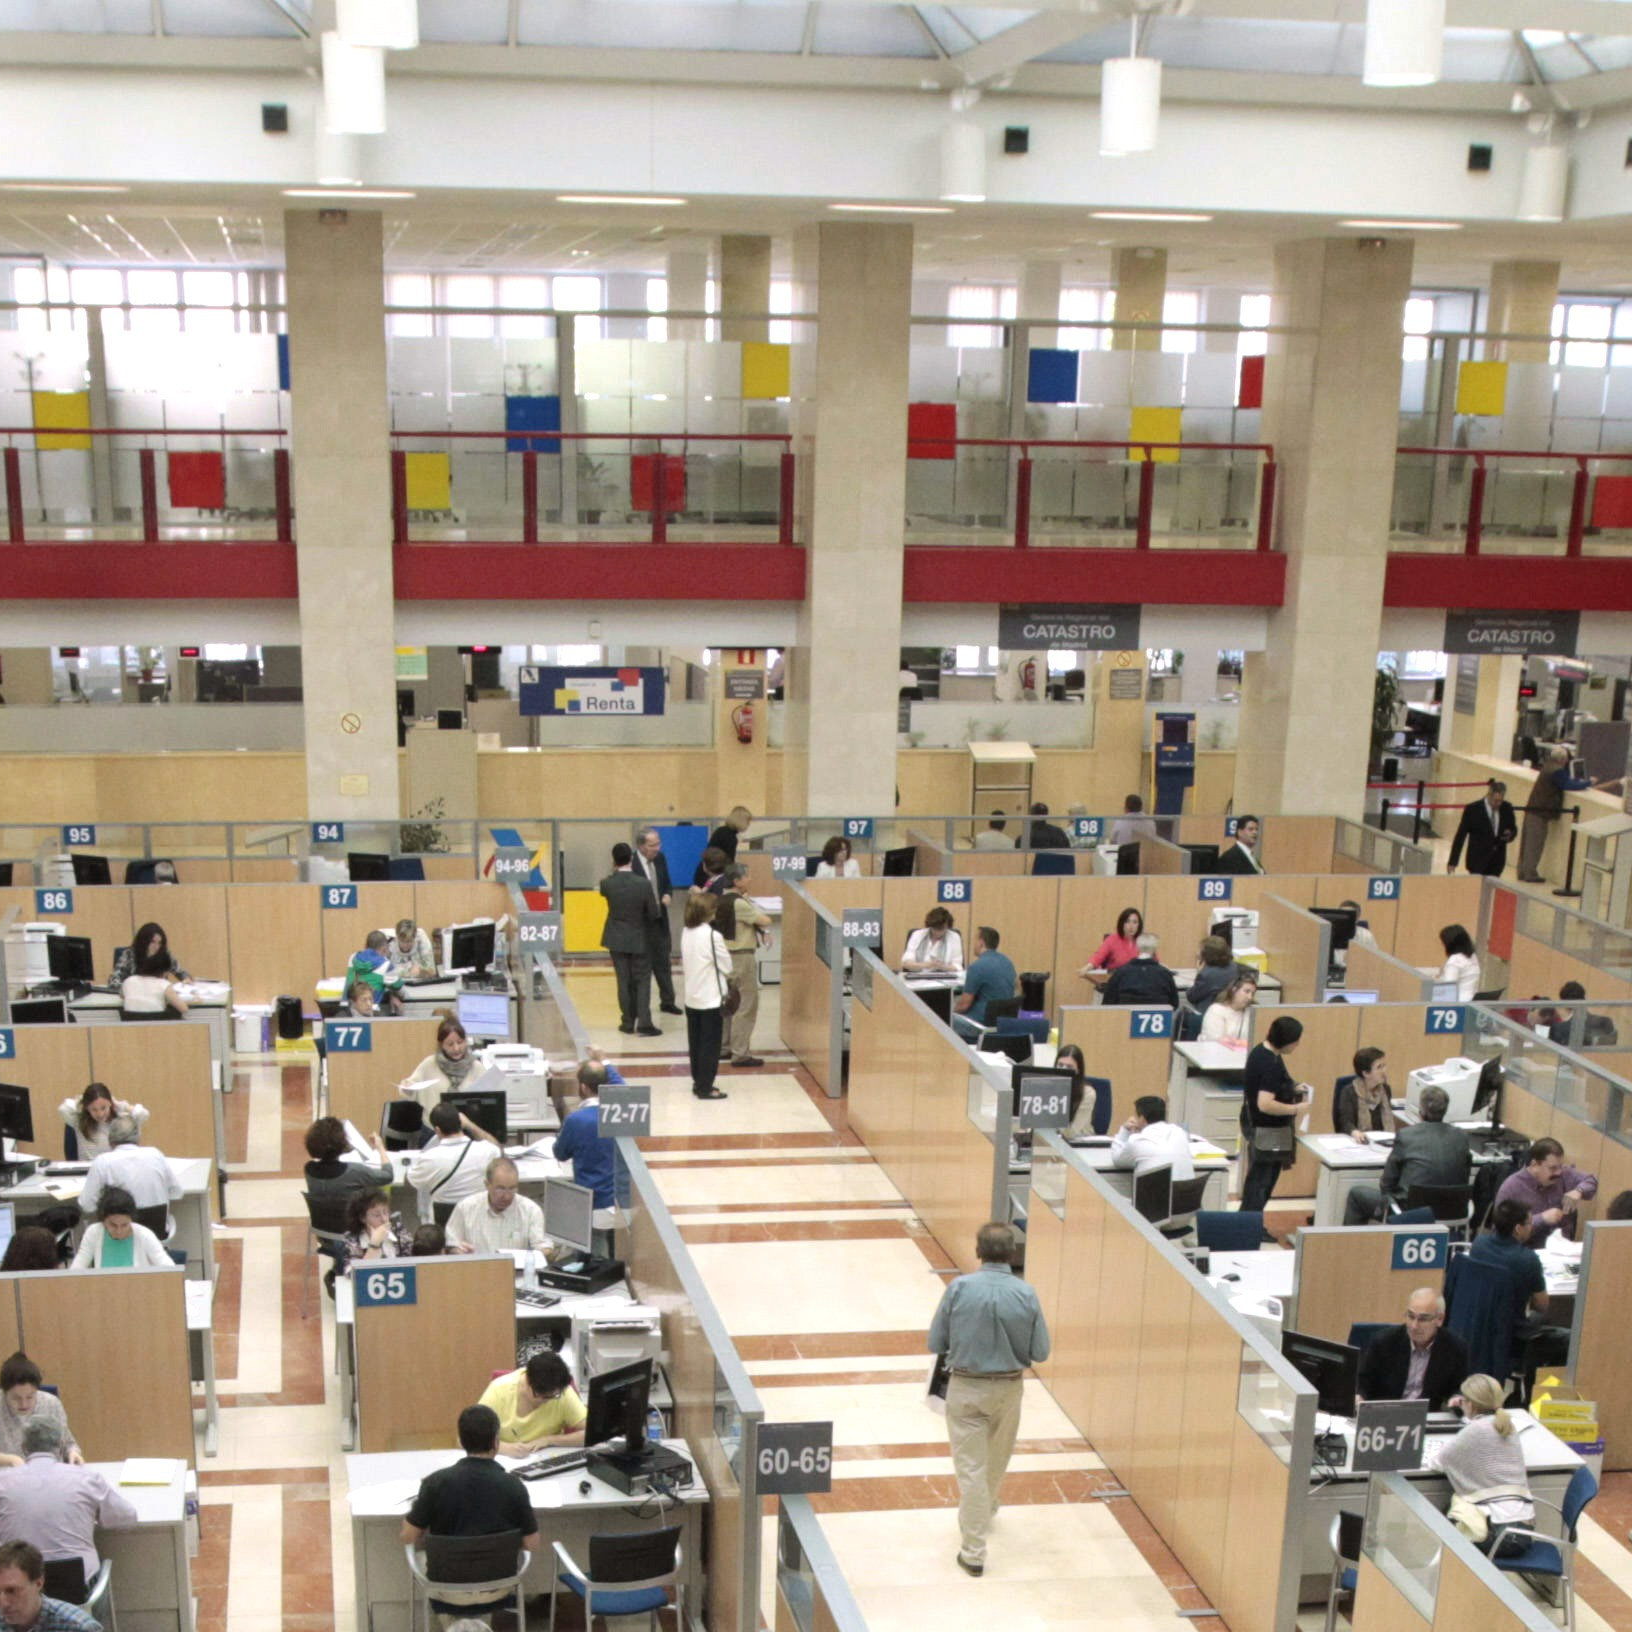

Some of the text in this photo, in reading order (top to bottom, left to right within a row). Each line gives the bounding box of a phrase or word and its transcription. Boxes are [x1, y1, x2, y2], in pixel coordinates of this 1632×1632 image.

[1022, 624, 1117, 640] CATASTRO
[1467, 628, 1556, 644] CATASTRO
[586, 696, 636, 711] Renta
[68, 826, 92, 844] 95
[317, 823, 340, 841] 94
[848, 818, 869, 836] 97
[1079, 819, 1099, 835] 98
[1229, 819, 1238, 836] 9
[495, 858, 529, 873] 94-96
[772, 856, 806, 872] 97-99
[327, 886, 352, 906] 87
[943, 882, 965, 900] 88
[1202, 879, 1226, 898] 89
[1372, 879, 1395, 897] 90
[42, 892, 67, 910] 86
[520, 925, 558, 942] 82-87
[842, 921, 880, 938] 88-93
[1137, 1012, 1165, 1035] 78
[1432, 1008, 1459, 1030] 79
[333, 1026, 363, 1048] 77
[599, 1102, 650, 1123] 72-77
[1021, 1095, 1069, 1115] 78-81
[1401, 1237, 1438, 1265] 66
[366, 1272, 407, 1301] 65
[1356, 1424, 1422, 1453] 66-71
[758, 1447, 831, 1475] 60-65
